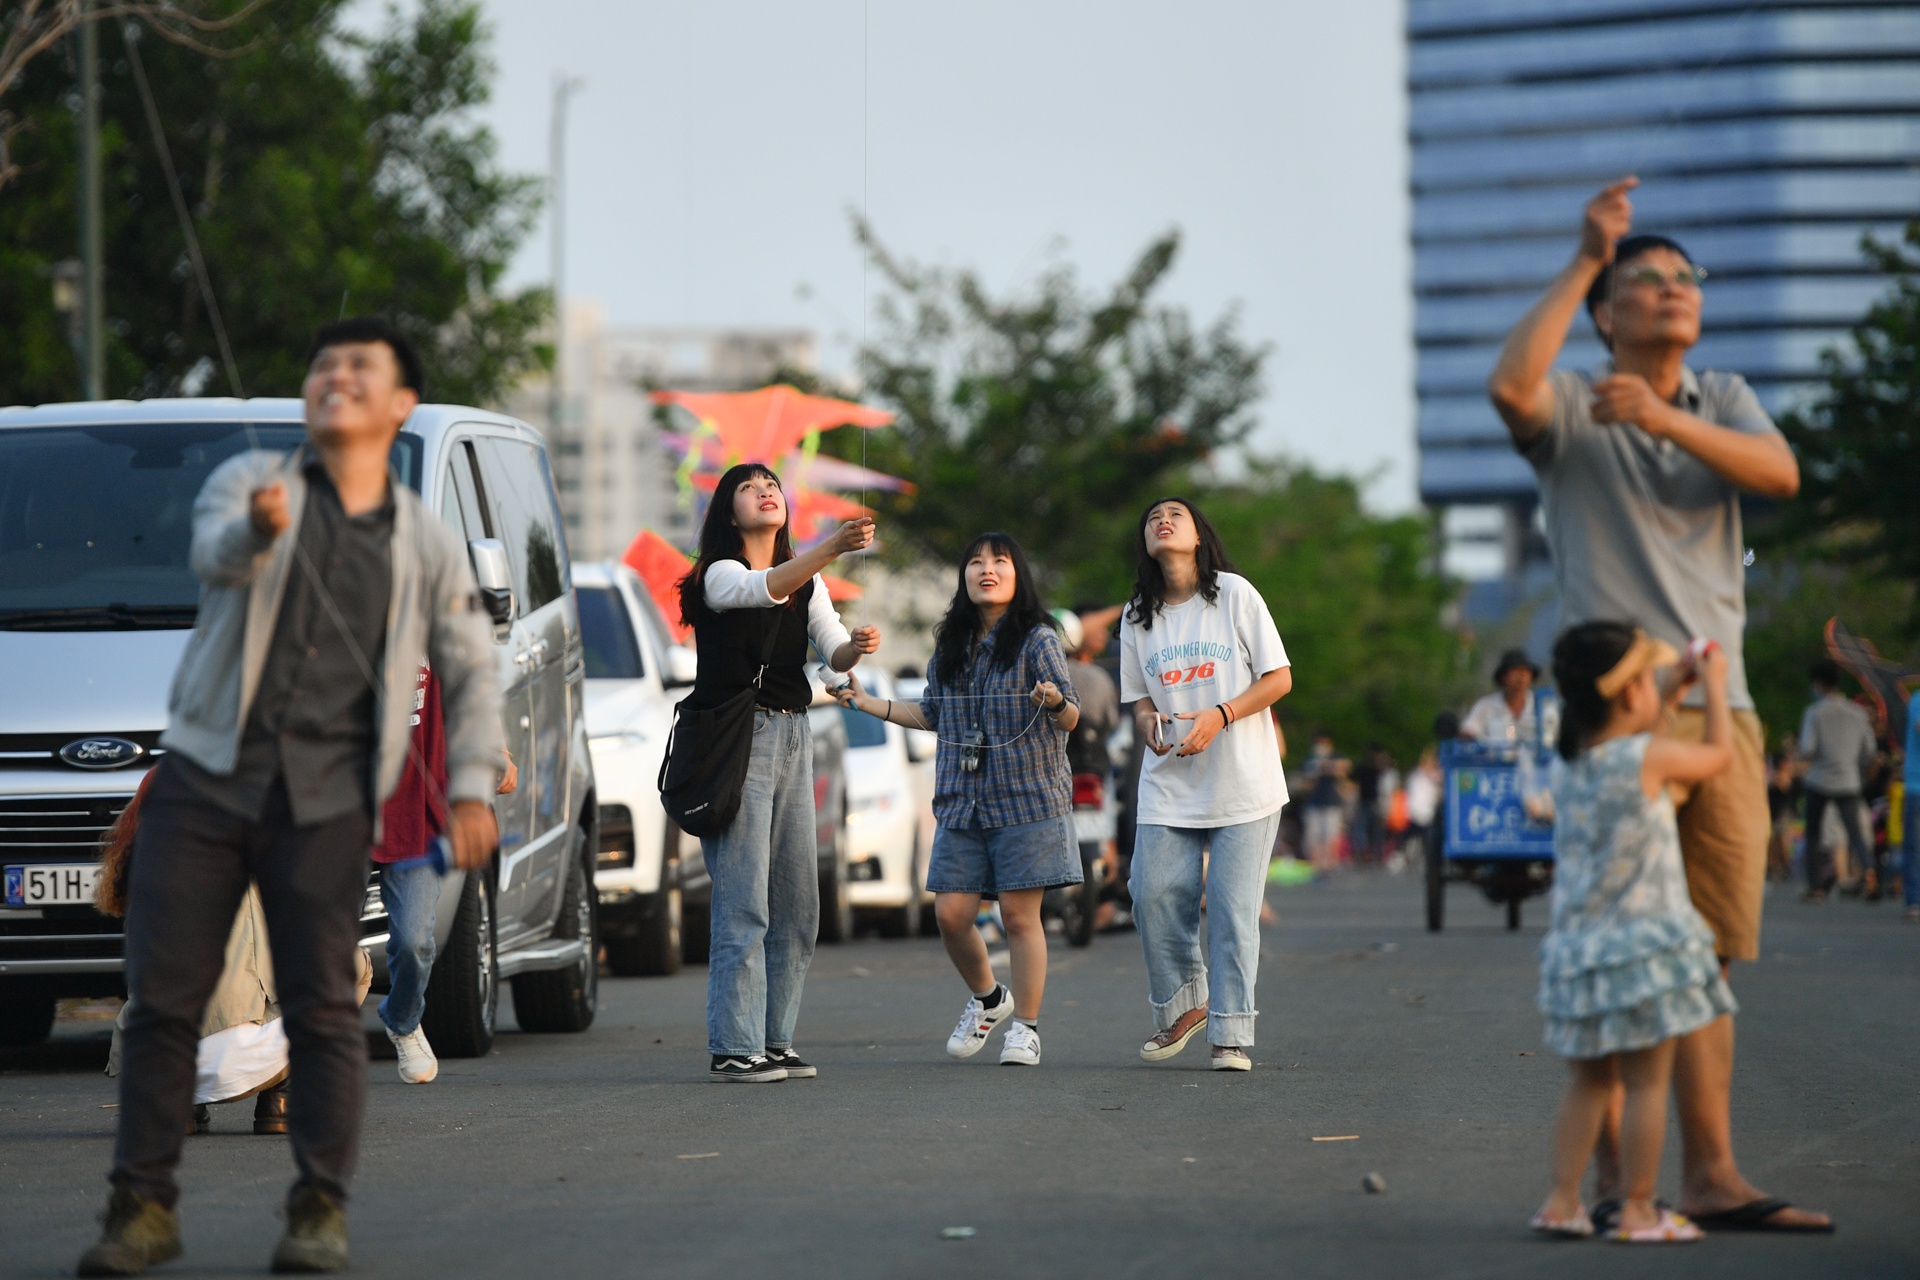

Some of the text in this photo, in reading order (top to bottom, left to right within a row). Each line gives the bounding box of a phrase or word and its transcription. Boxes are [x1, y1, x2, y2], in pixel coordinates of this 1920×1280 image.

[1161, 641, 1232, 662] SUMMERWOOD
[1158, 661, 1215, 687] 1976
[77, 740, 123, 759] Ford
[29, 869, 101, 900] 51H-
